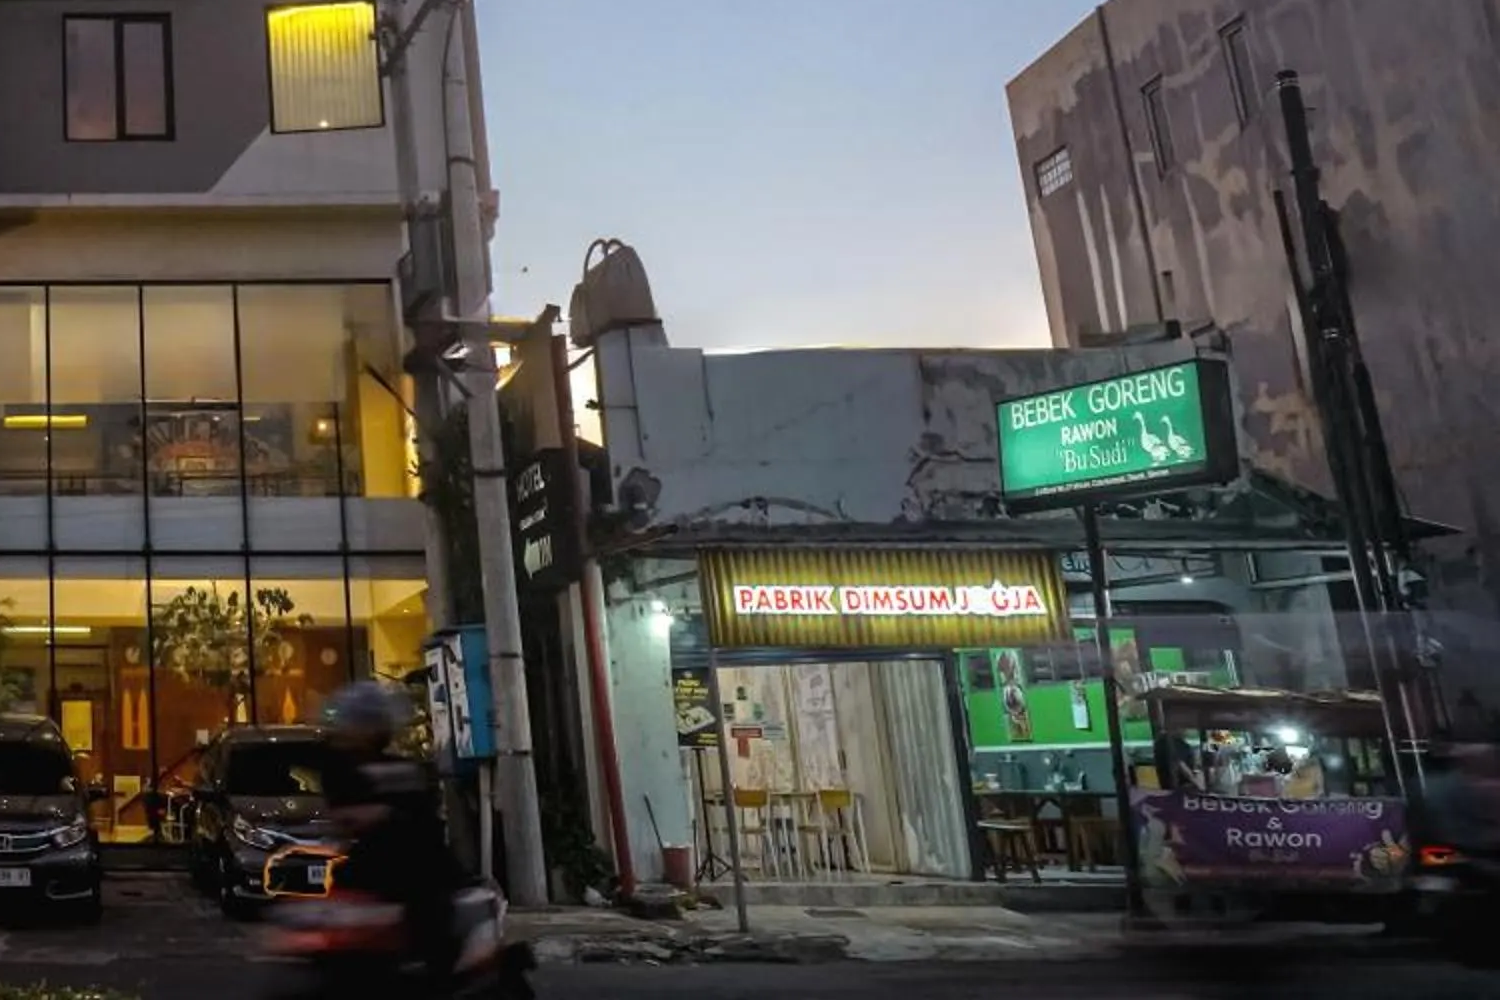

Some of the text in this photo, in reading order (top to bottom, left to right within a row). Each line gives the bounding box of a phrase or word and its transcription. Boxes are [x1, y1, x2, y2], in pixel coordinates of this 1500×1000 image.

[1011, 367, 1186, 430] BEBEK GORENG
[1061, 418, 1118, 446] RAWON
[739, 588, 832, 611] PABRIK
[845, 588, 951, 611] DIMSUM
[1266, 817, 1283, 830] &
[1226, 828, 1323, 848] Rawon
